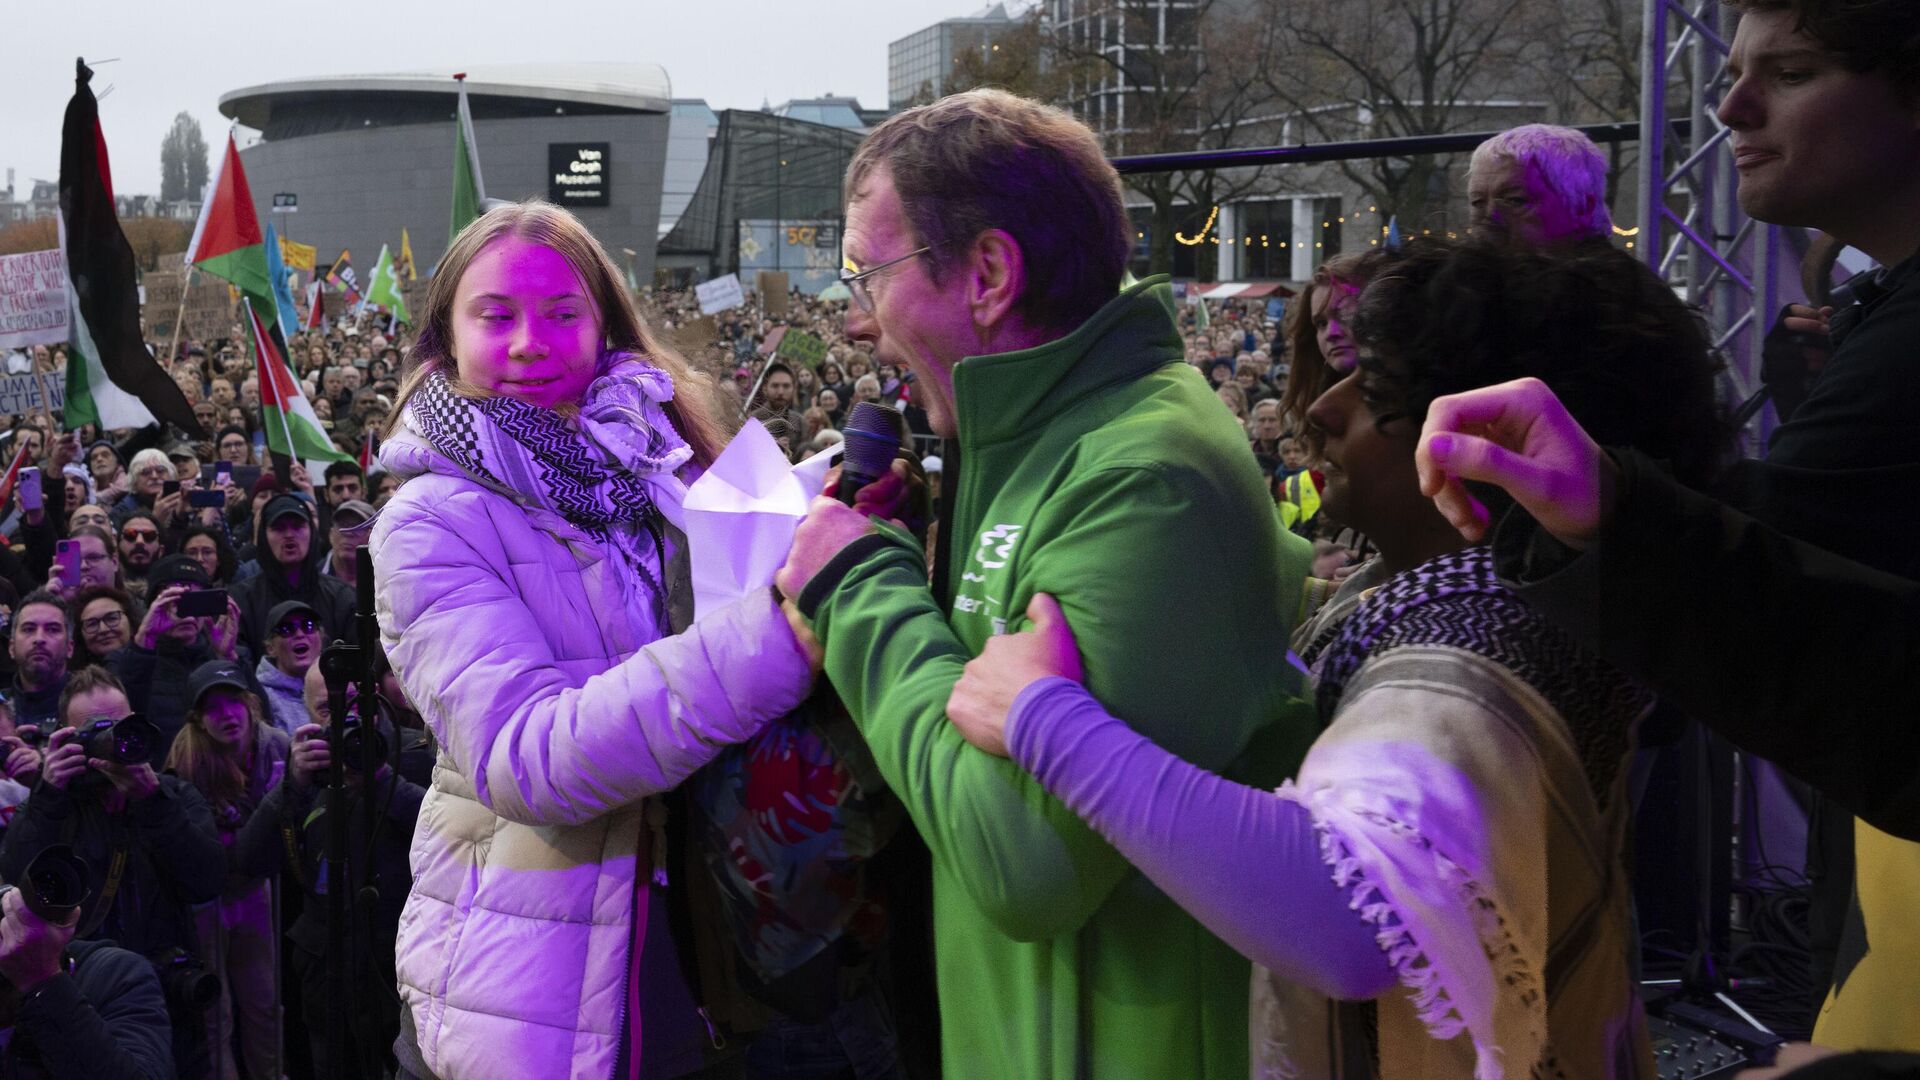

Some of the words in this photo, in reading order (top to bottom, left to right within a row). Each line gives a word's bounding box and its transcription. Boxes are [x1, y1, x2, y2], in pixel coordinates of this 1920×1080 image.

[578, 149, 602, 161] Van
[570, 160, 602, 174] Gogh
[555, 173, 602, 185] Museum
[0, 275, 38, 296] LESTINE
[0, 373, 65, 393] IMAAT-
[0, 391, 43, 413] CTIE
